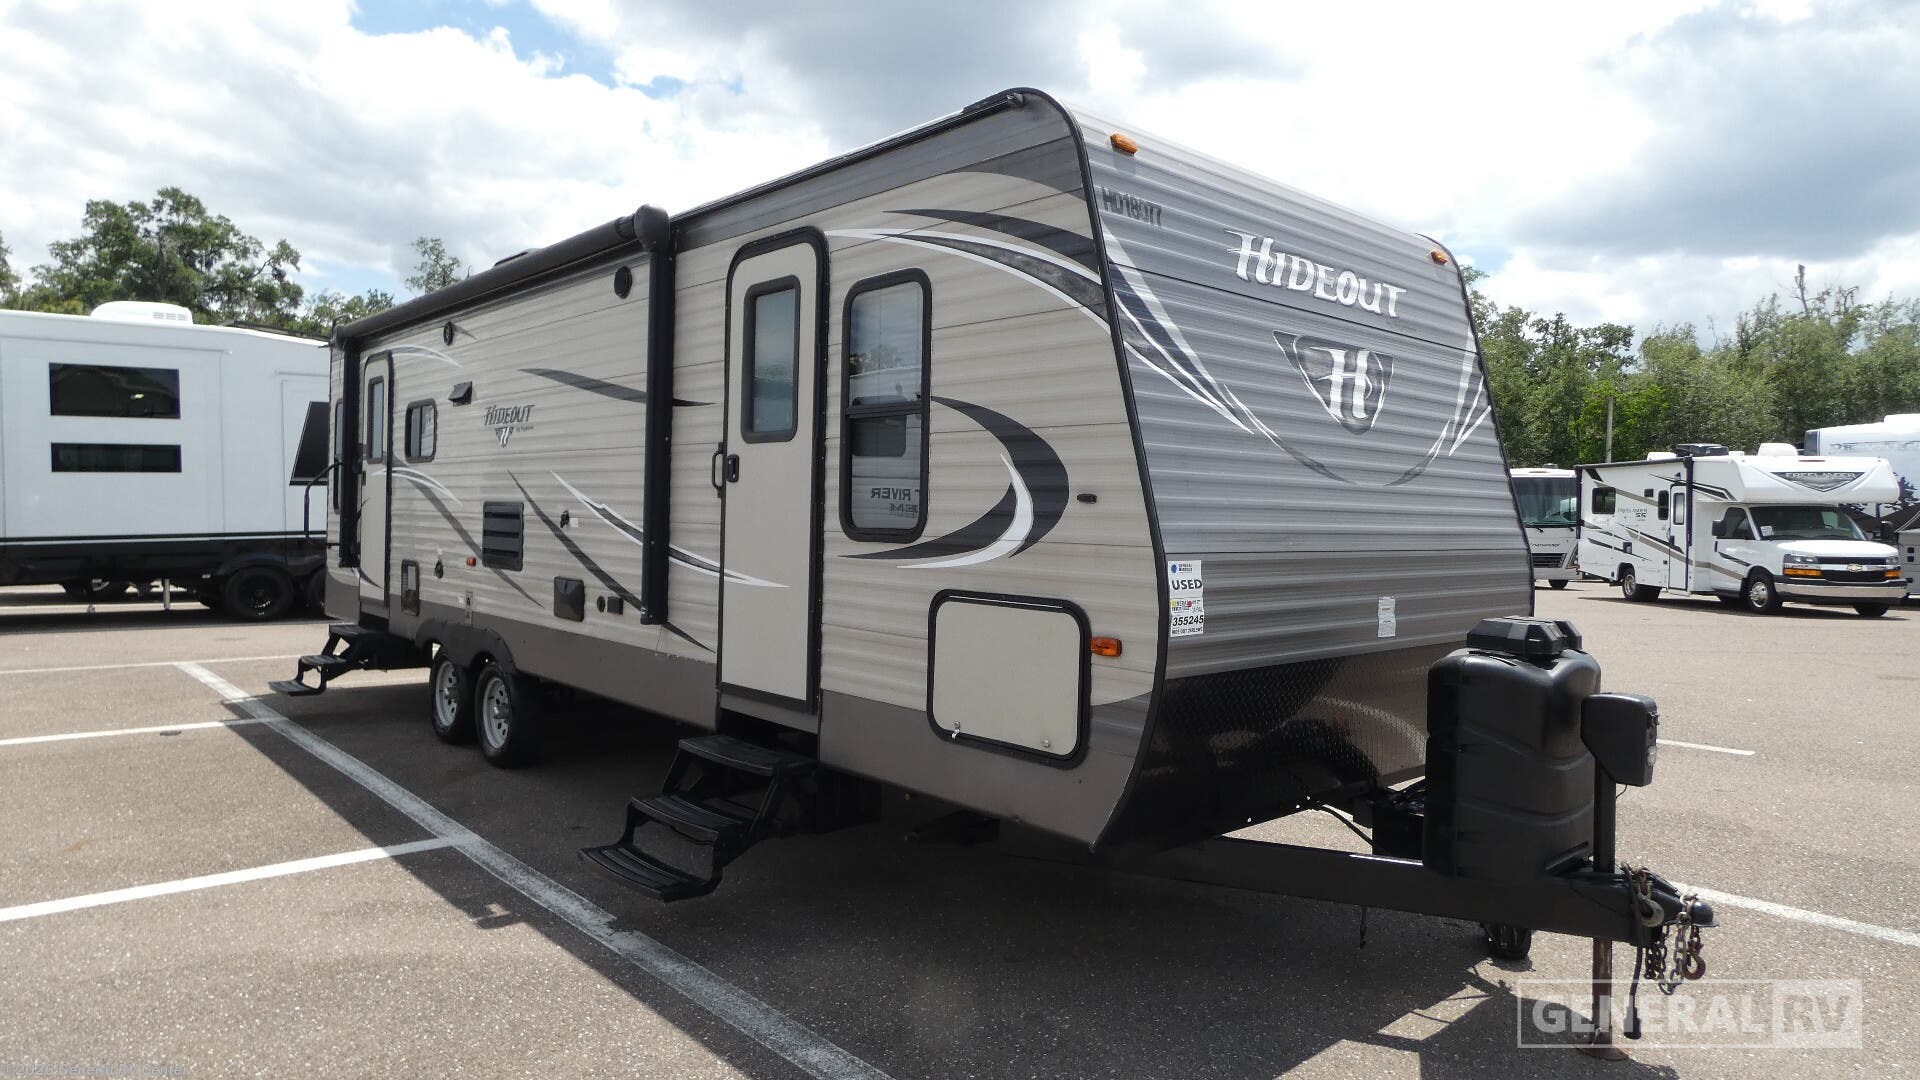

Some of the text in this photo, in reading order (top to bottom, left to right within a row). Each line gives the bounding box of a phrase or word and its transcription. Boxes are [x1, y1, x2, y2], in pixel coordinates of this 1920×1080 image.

[1224, 229, 1408, 318] HIDEOUT
[484, 404, 536, 425] HIDEOUT
[1172, 579, 1203, 590] USED
[1172, 615, 1204, 626] 355245
